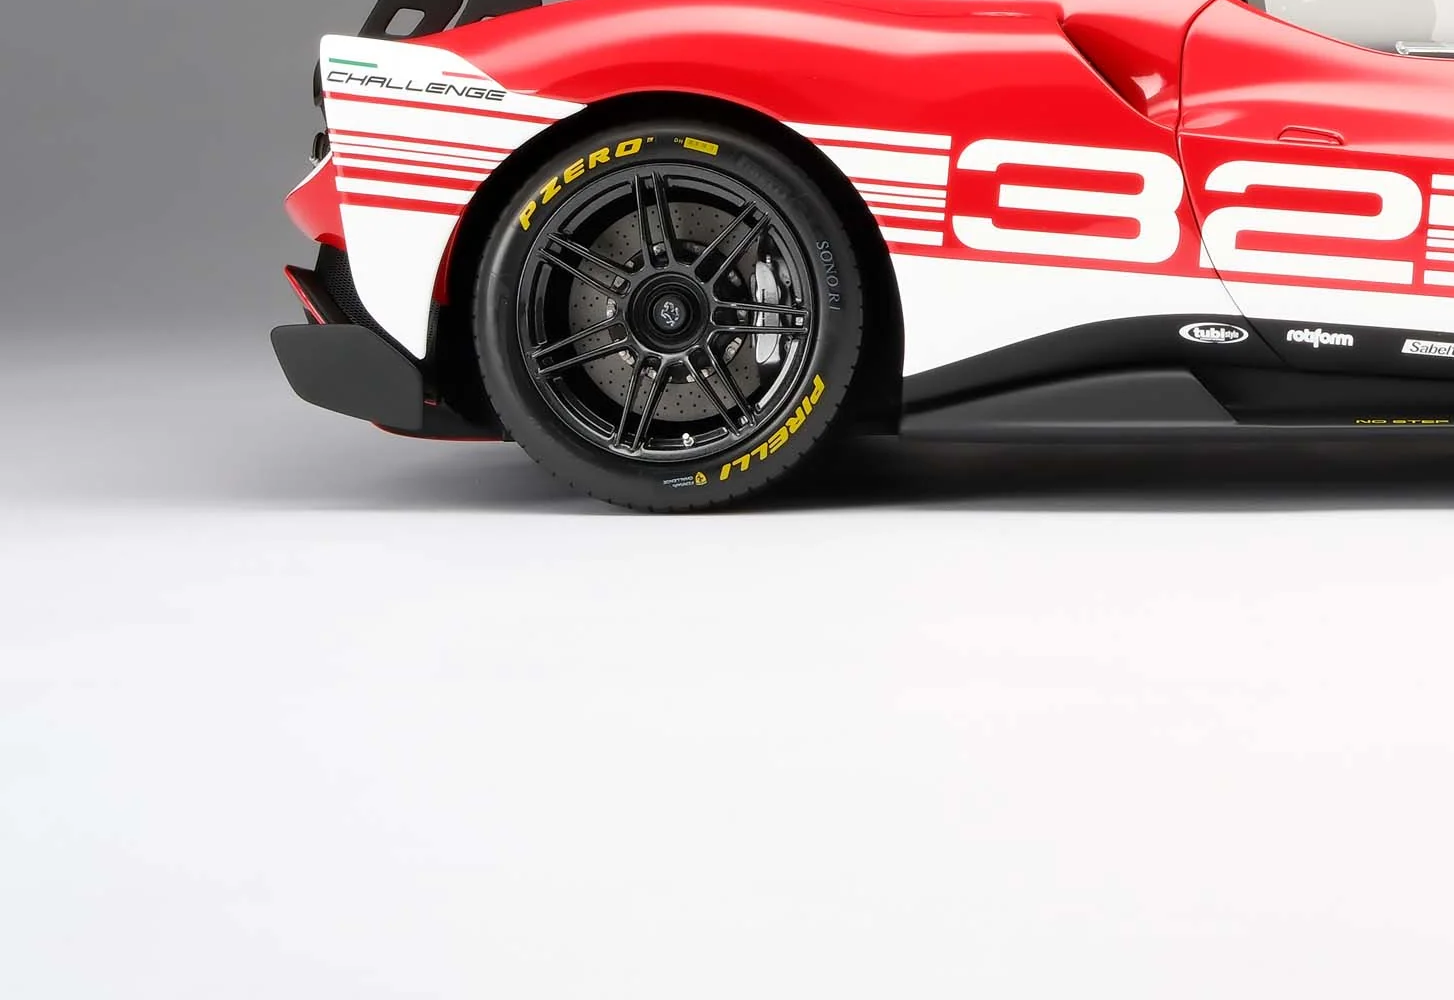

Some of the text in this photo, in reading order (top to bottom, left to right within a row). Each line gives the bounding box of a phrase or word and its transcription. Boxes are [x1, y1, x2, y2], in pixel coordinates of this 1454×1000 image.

[327, 71, 507, 101] CHALLENGE
[952, 139, 1422, 284] 32
[1193, 327, 1226, 339] tubi
[719, 374, 825, 481] PIRELLI
